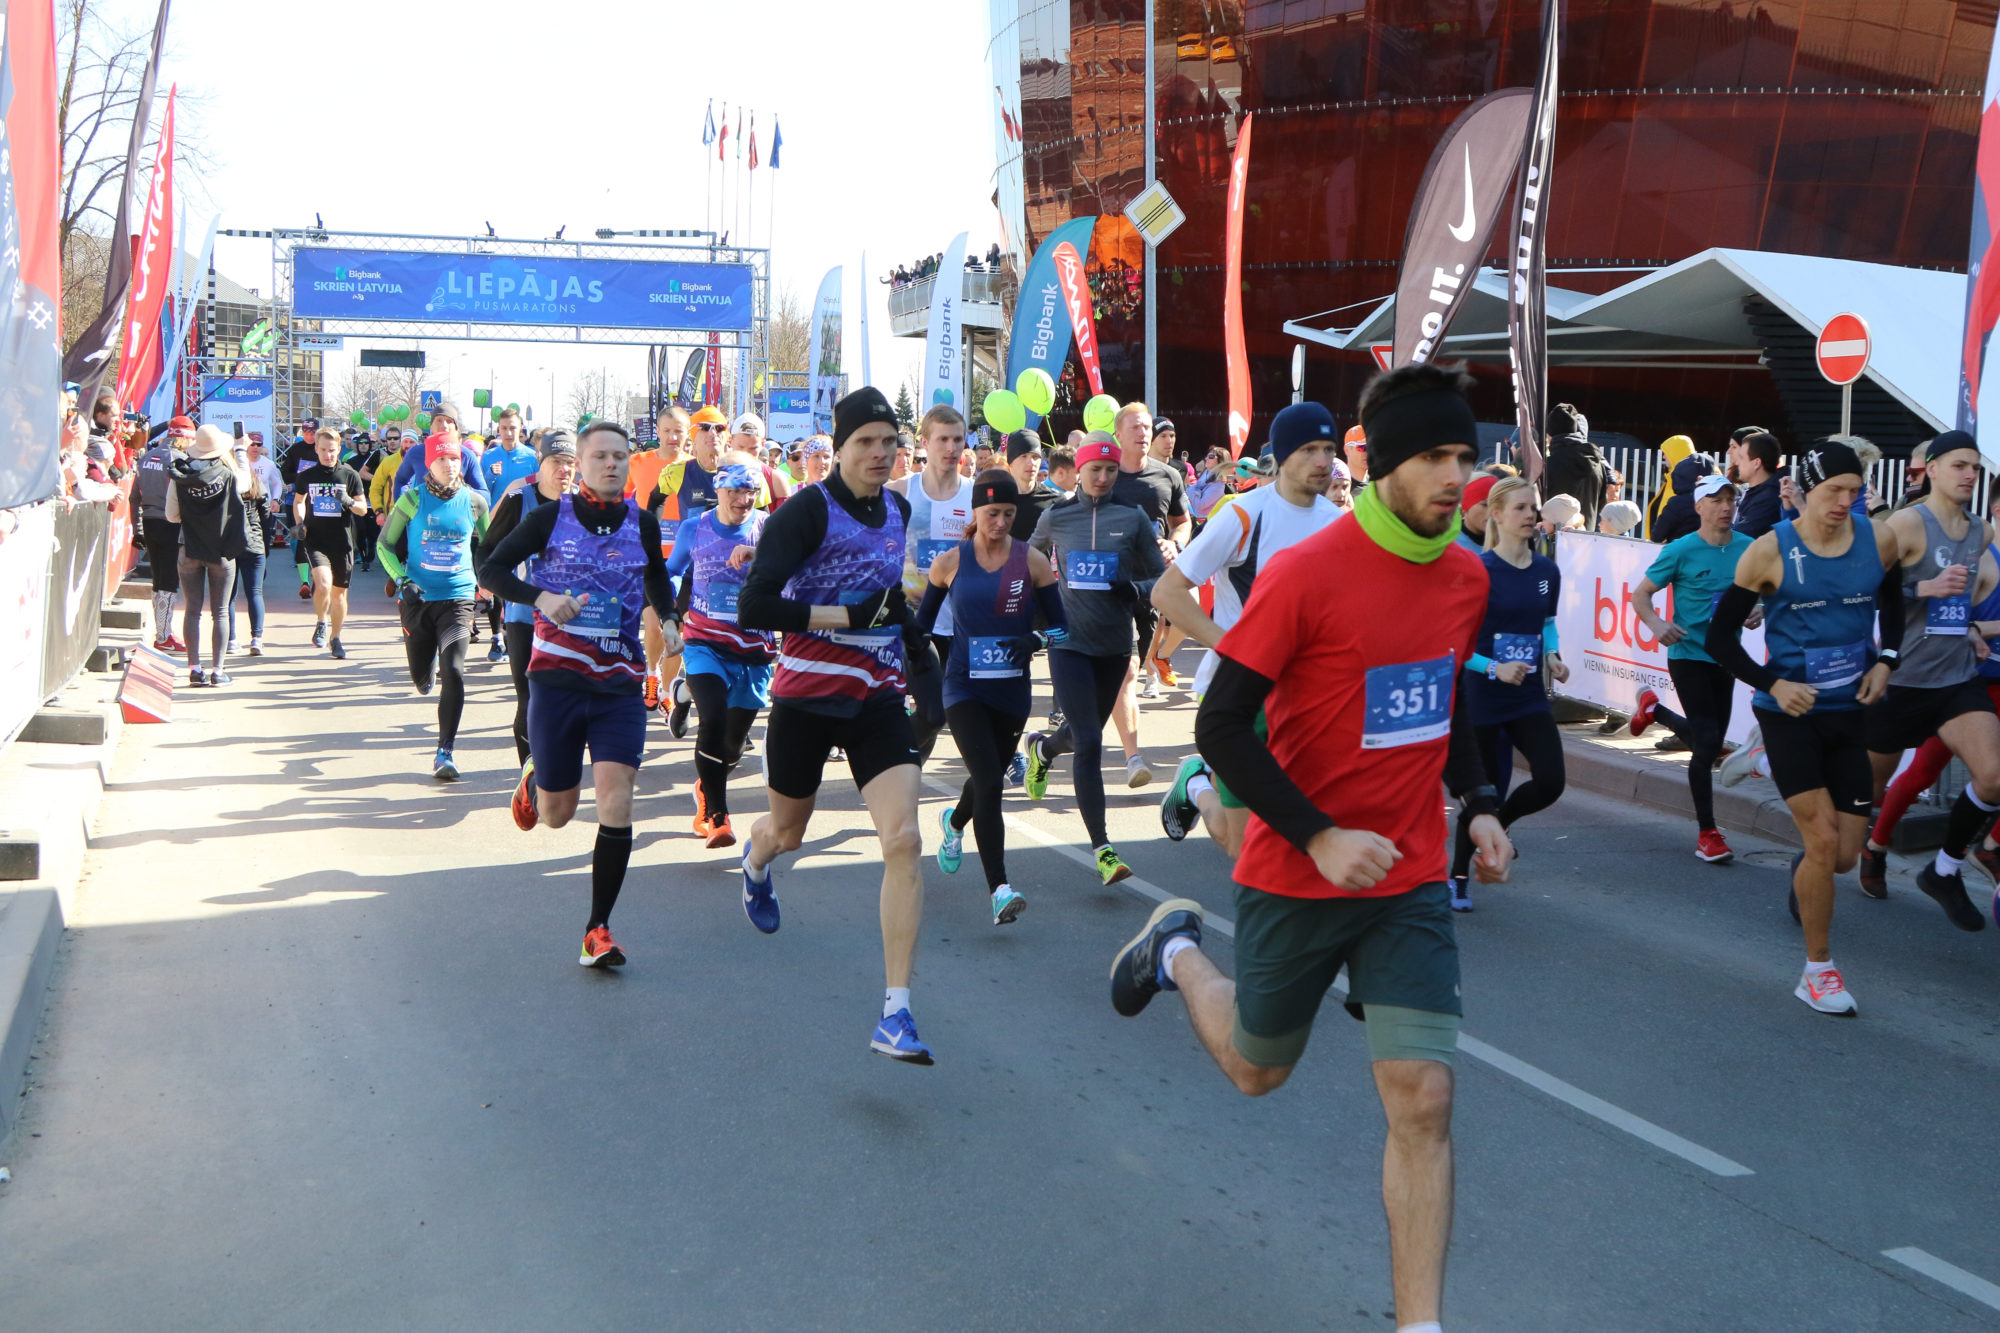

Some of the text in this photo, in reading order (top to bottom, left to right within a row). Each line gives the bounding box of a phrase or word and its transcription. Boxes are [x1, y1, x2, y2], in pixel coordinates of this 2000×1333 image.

[348, 270, 381, 280] Bigbank
[313, 281, 403, 294] SKRIEN LATVIJA
[448, 268, 604, 303] LIEPĀJAS
[681, 282, 712, 292] Bigbank
[1428, 263, 1465, 305] IT.
[648, 293, 733, 305] SKRIEN LATVIJA
[474, 301, 577, 314] PUSMARATONS
[1031, 282, 1059, 361] Bigbank
[938, 297, 955, 380] Bigbank
[228, 387, 262, 397] Bigbank
[142, 461, 163, 471] LATVIA
[319, 502, 336, 510] 265
[1076, 562, 1105, 577] 371
[1791, 600, 1827, 610] SYFORM
[1938, 605, 1966, 620] 283
[1505, 645, 1534, 660] 362
[1583, 658, 1610, 674] VIENNA
[1612, 667, 1657, 687] INSURANCE
[1388, 684, 1438, 718] 351
